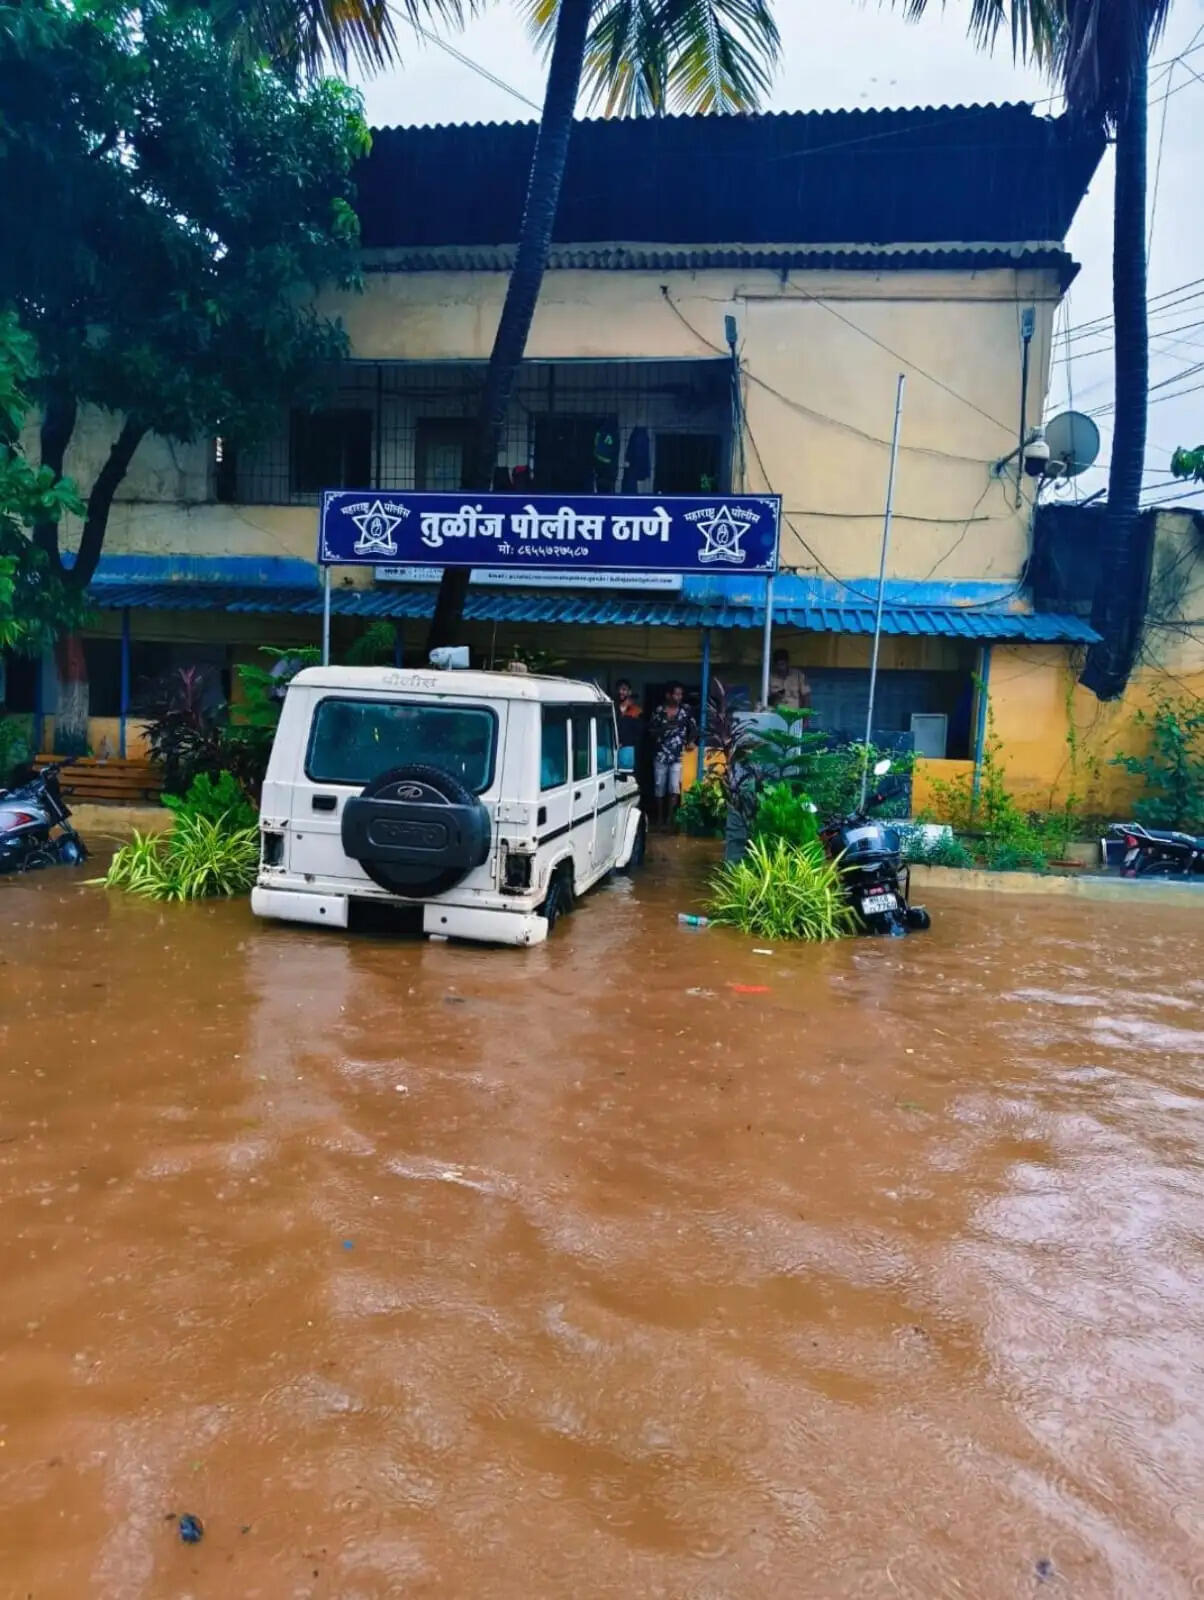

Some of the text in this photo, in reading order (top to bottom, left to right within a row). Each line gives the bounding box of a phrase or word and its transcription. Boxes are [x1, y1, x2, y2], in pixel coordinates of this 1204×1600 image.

[731, 506, 761, 523] पोलीस
[420, 504, 672, 547] तुळींज पोलीस ठाणे
[382, 672, 438, 688] पोलीस
